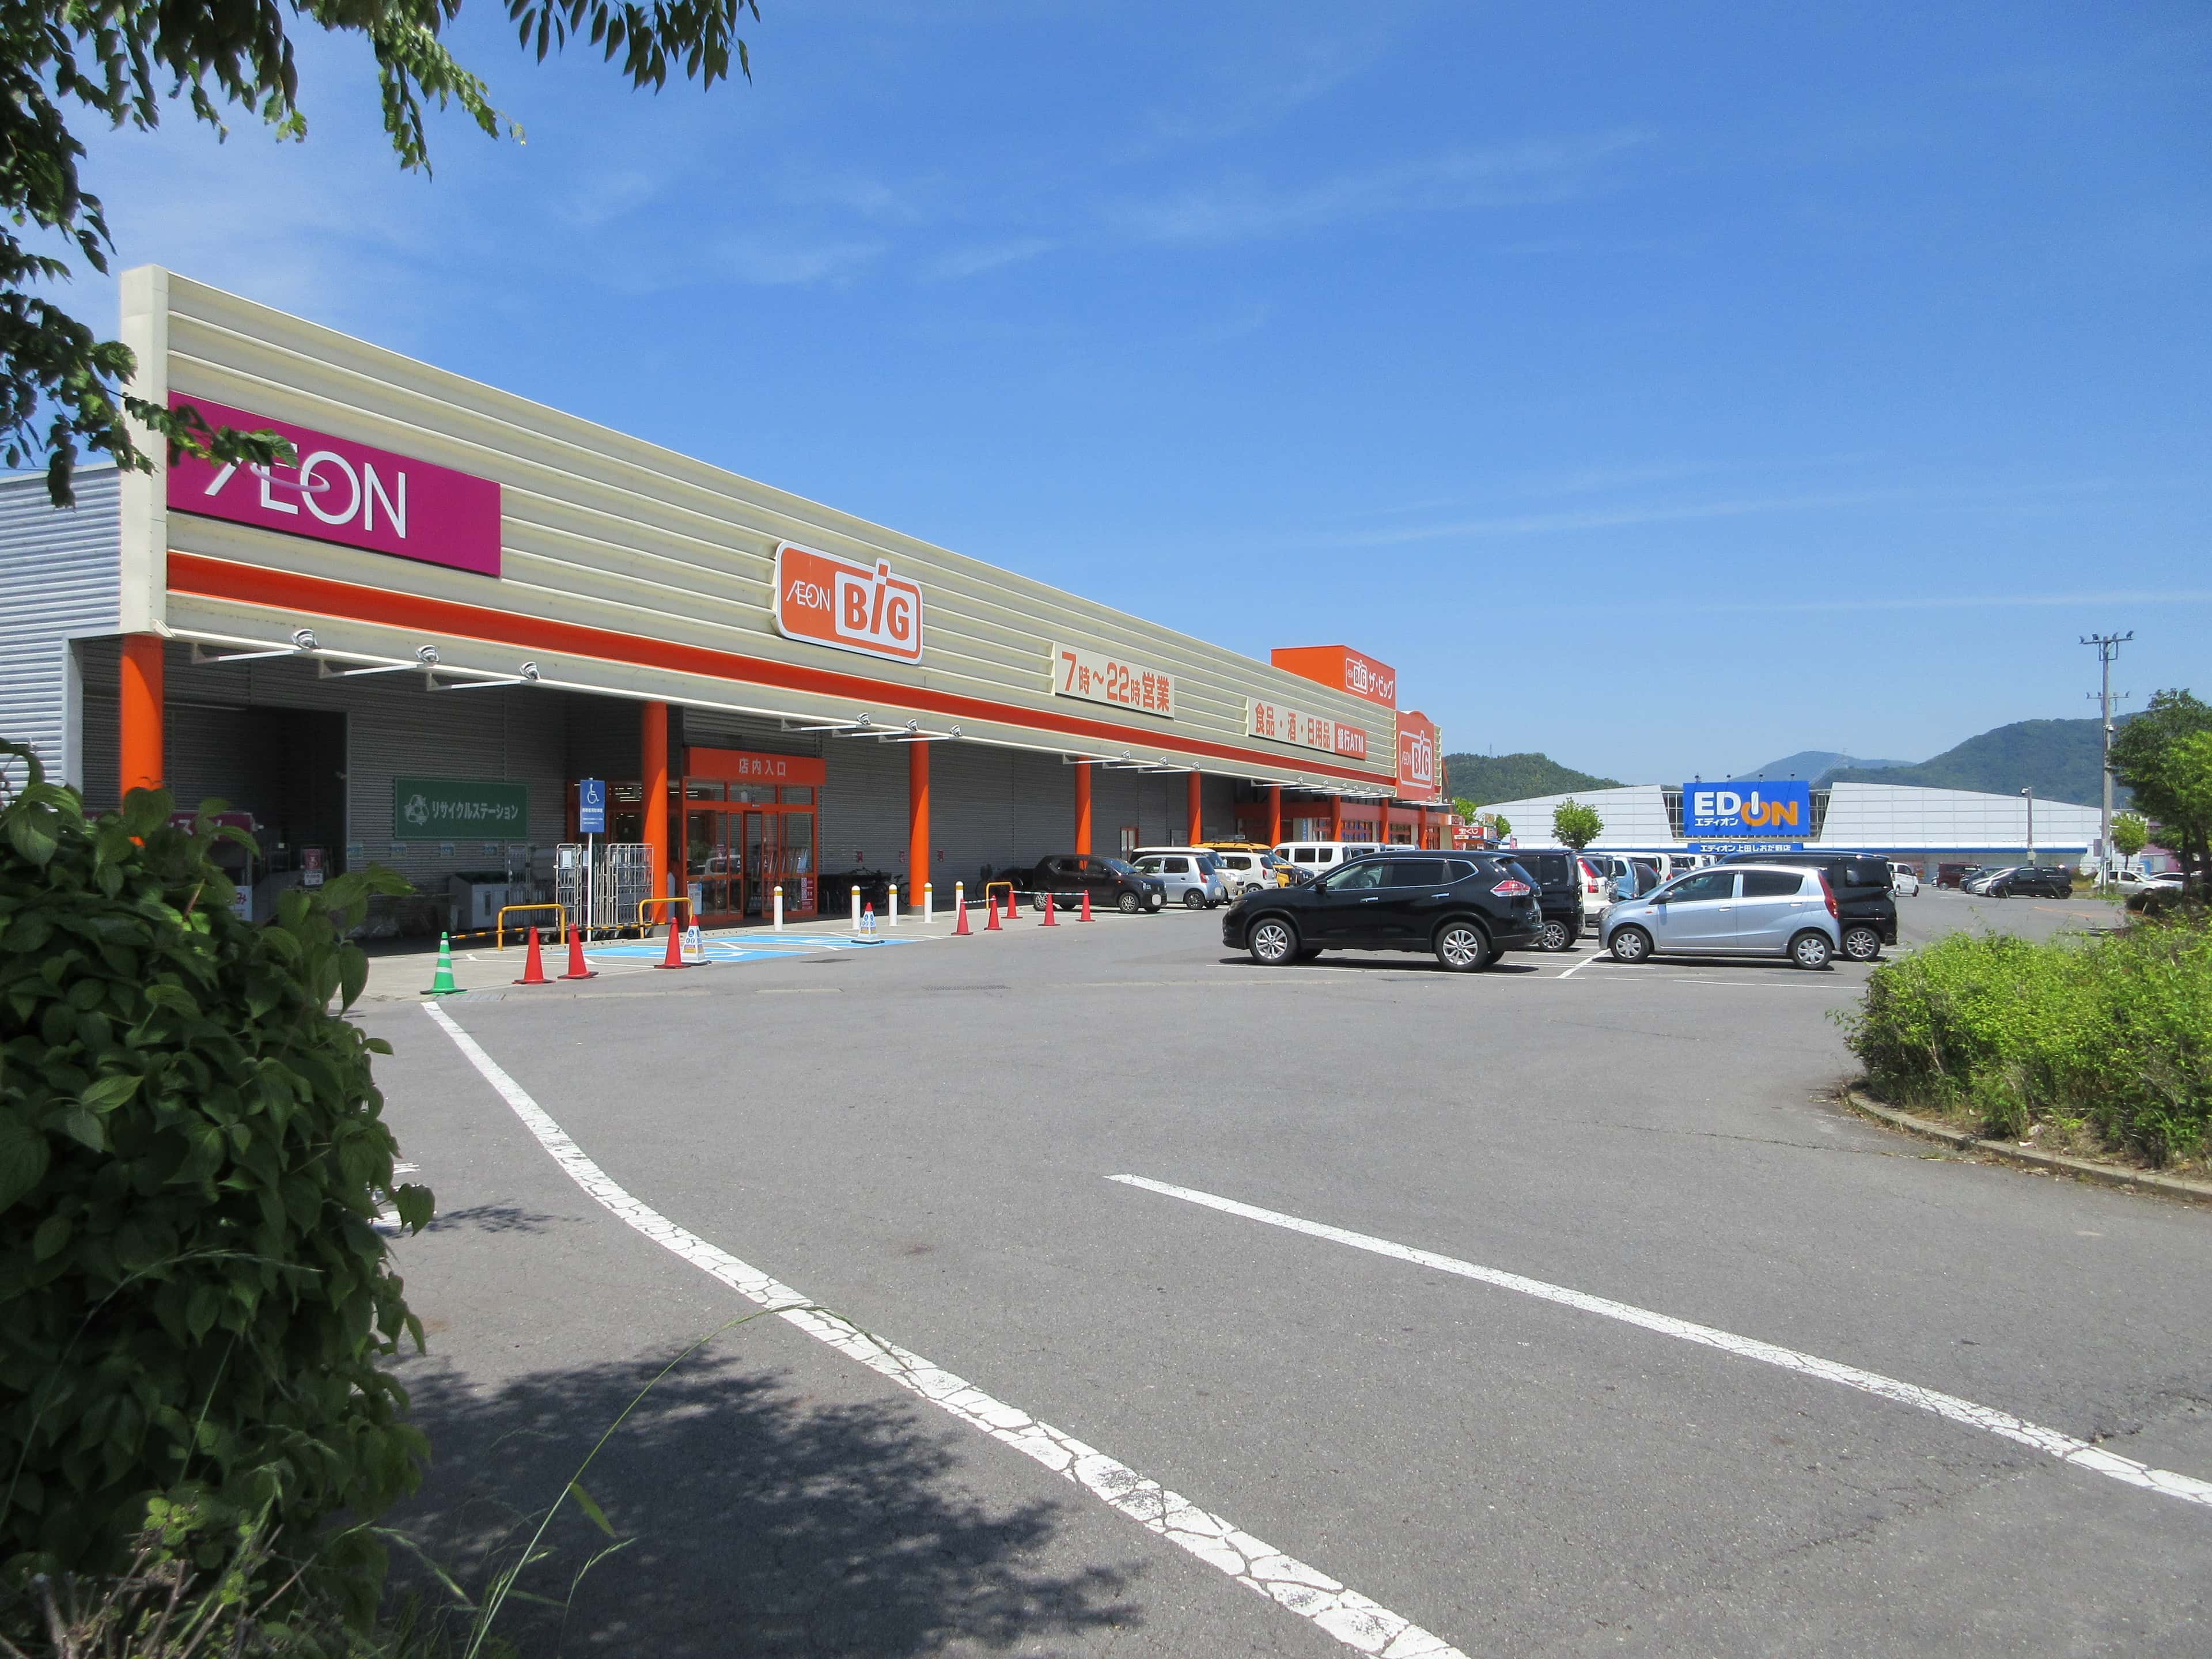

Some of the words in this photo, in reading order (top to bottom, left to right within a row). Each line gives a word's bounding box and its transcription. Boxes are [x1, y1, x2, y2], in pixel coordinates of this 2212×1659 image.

[1255, 702, 1330, 749] 食品・酒・日用品
[739, 758, 786, 776] 店内入口
[432, 801, 518, 820] リサイクルステーション
[1694, 791, 1798, 827] EDION
[1694, 818, 1738, 826] エディオン
